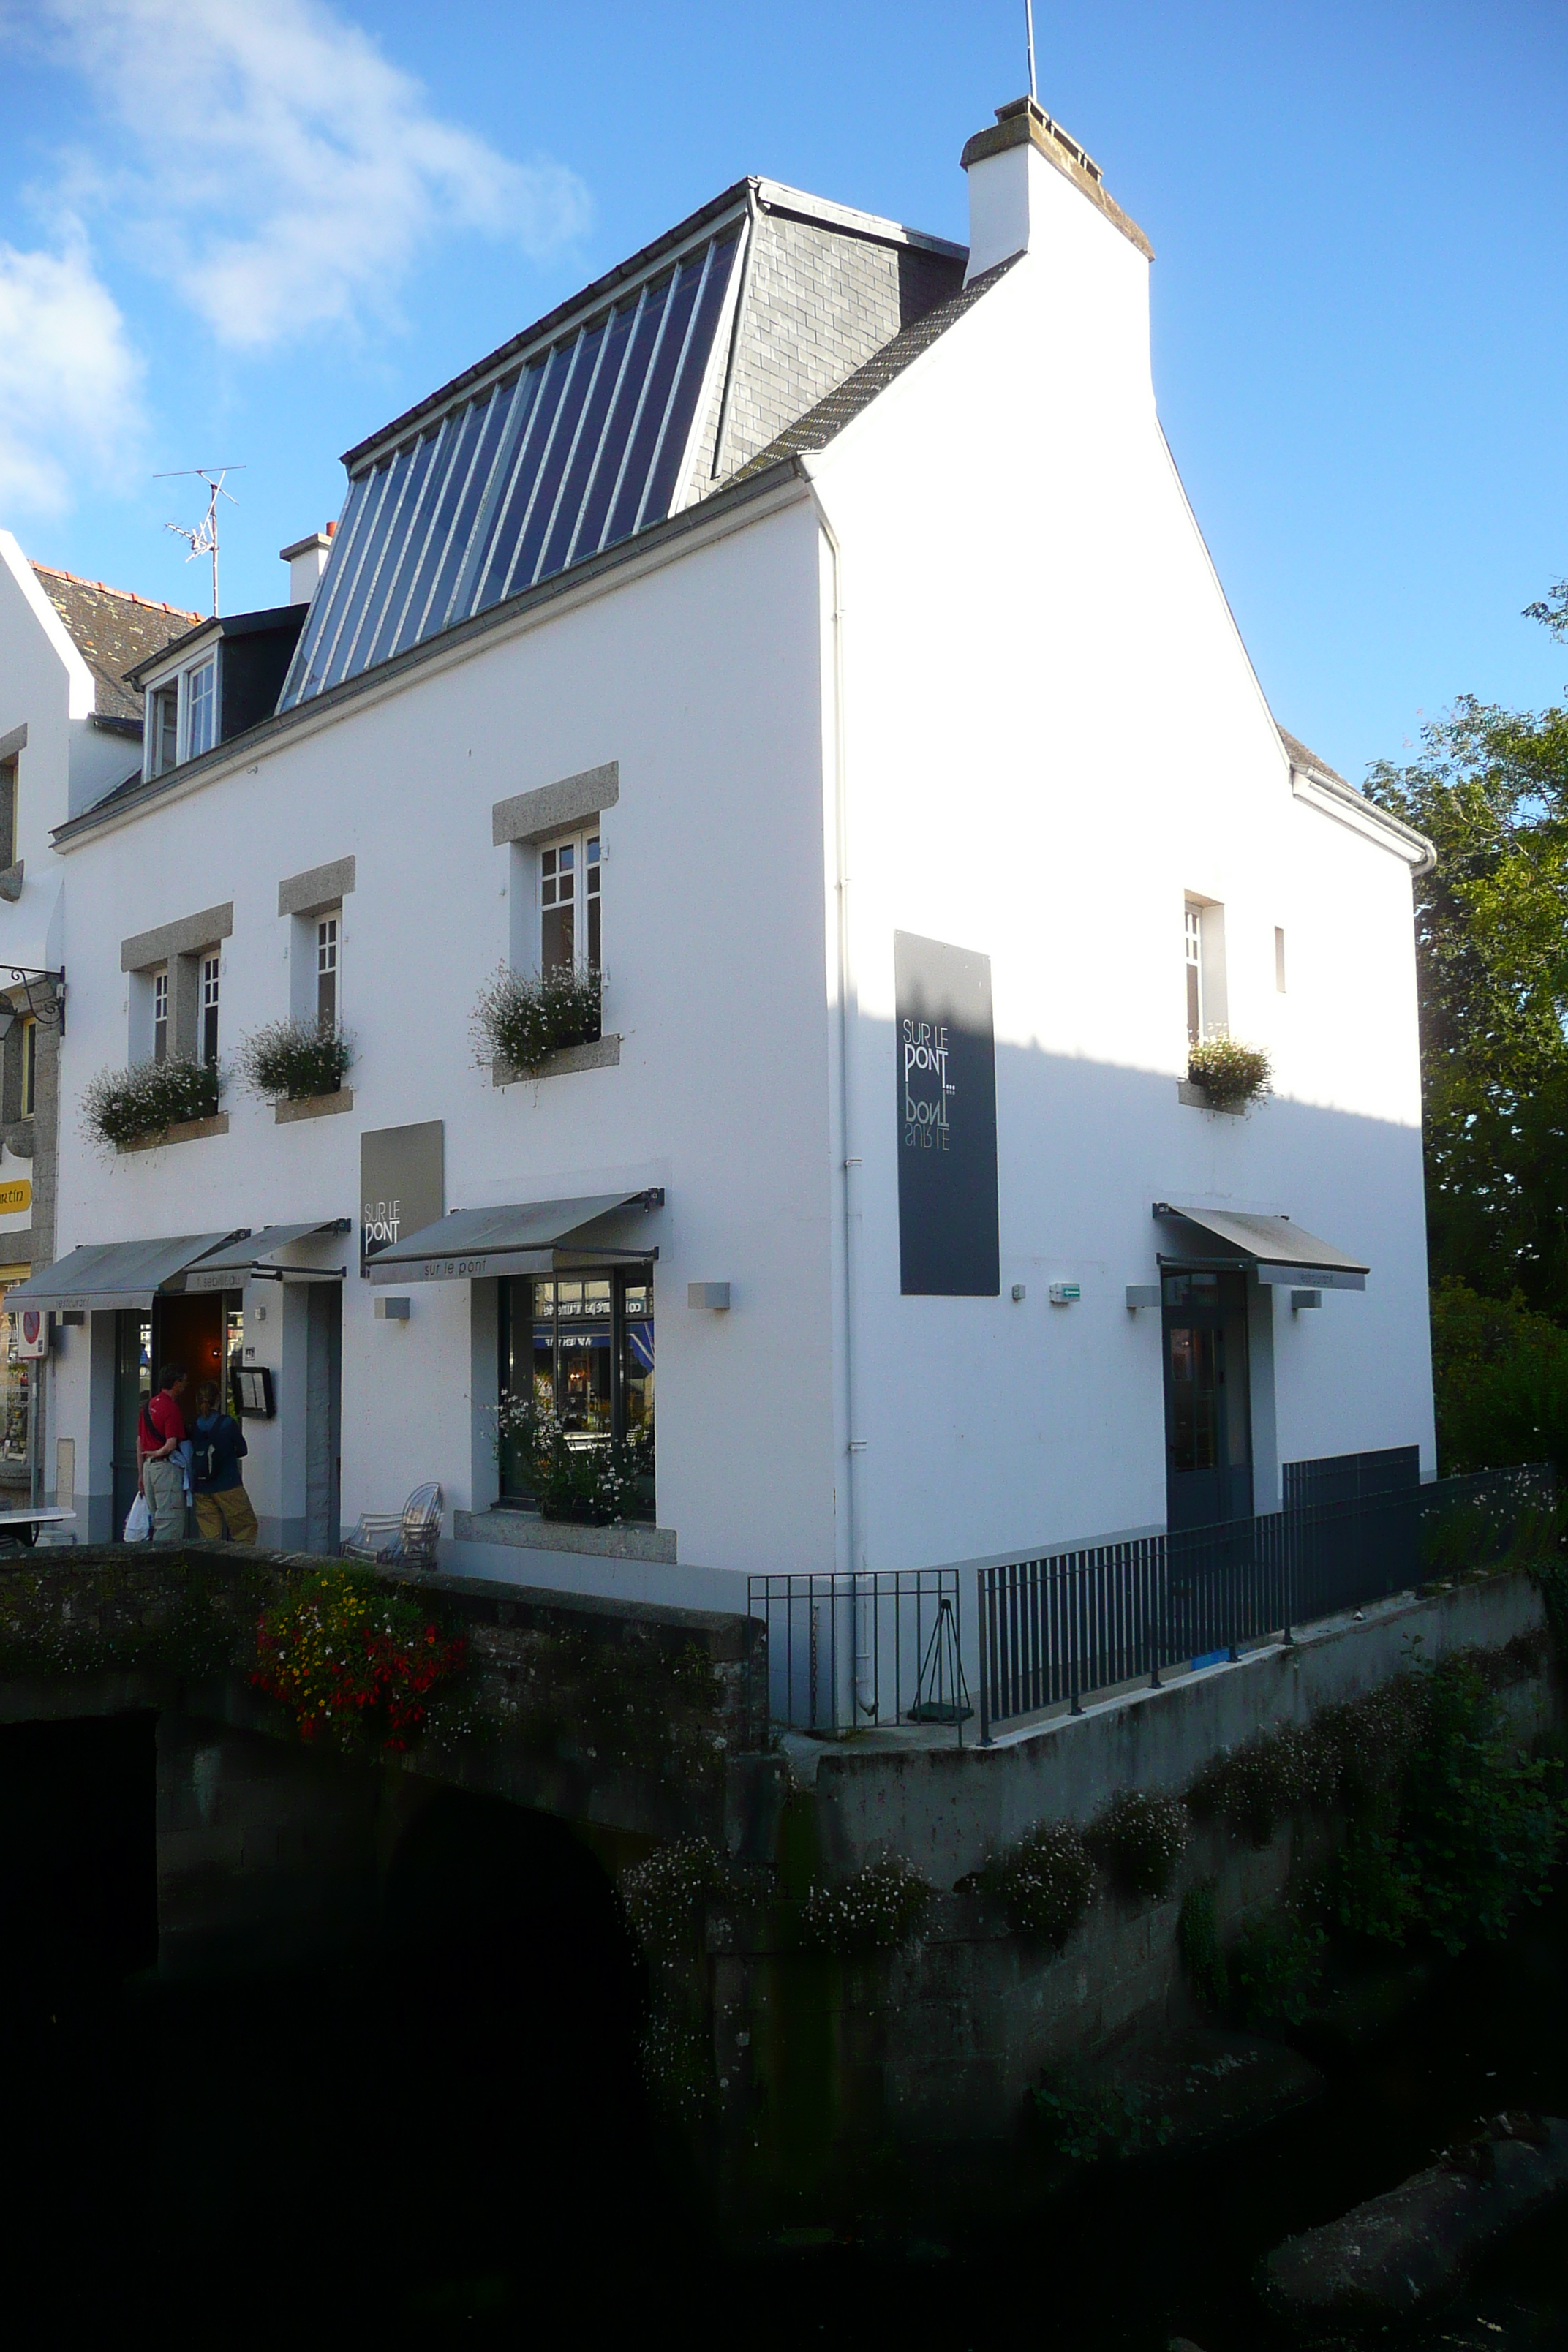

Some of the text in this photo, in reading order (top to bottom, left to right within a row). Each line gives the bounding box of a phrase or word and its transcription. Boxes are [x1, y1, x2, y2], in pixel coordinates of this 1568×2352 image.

[903, 1019, 949, 1051] SUR LE
[364, 1200, 400, 1223] SUR LE
[365, 1220, 400, 1255] PONT
[424, 1257, 486, 1276] sur le pont
